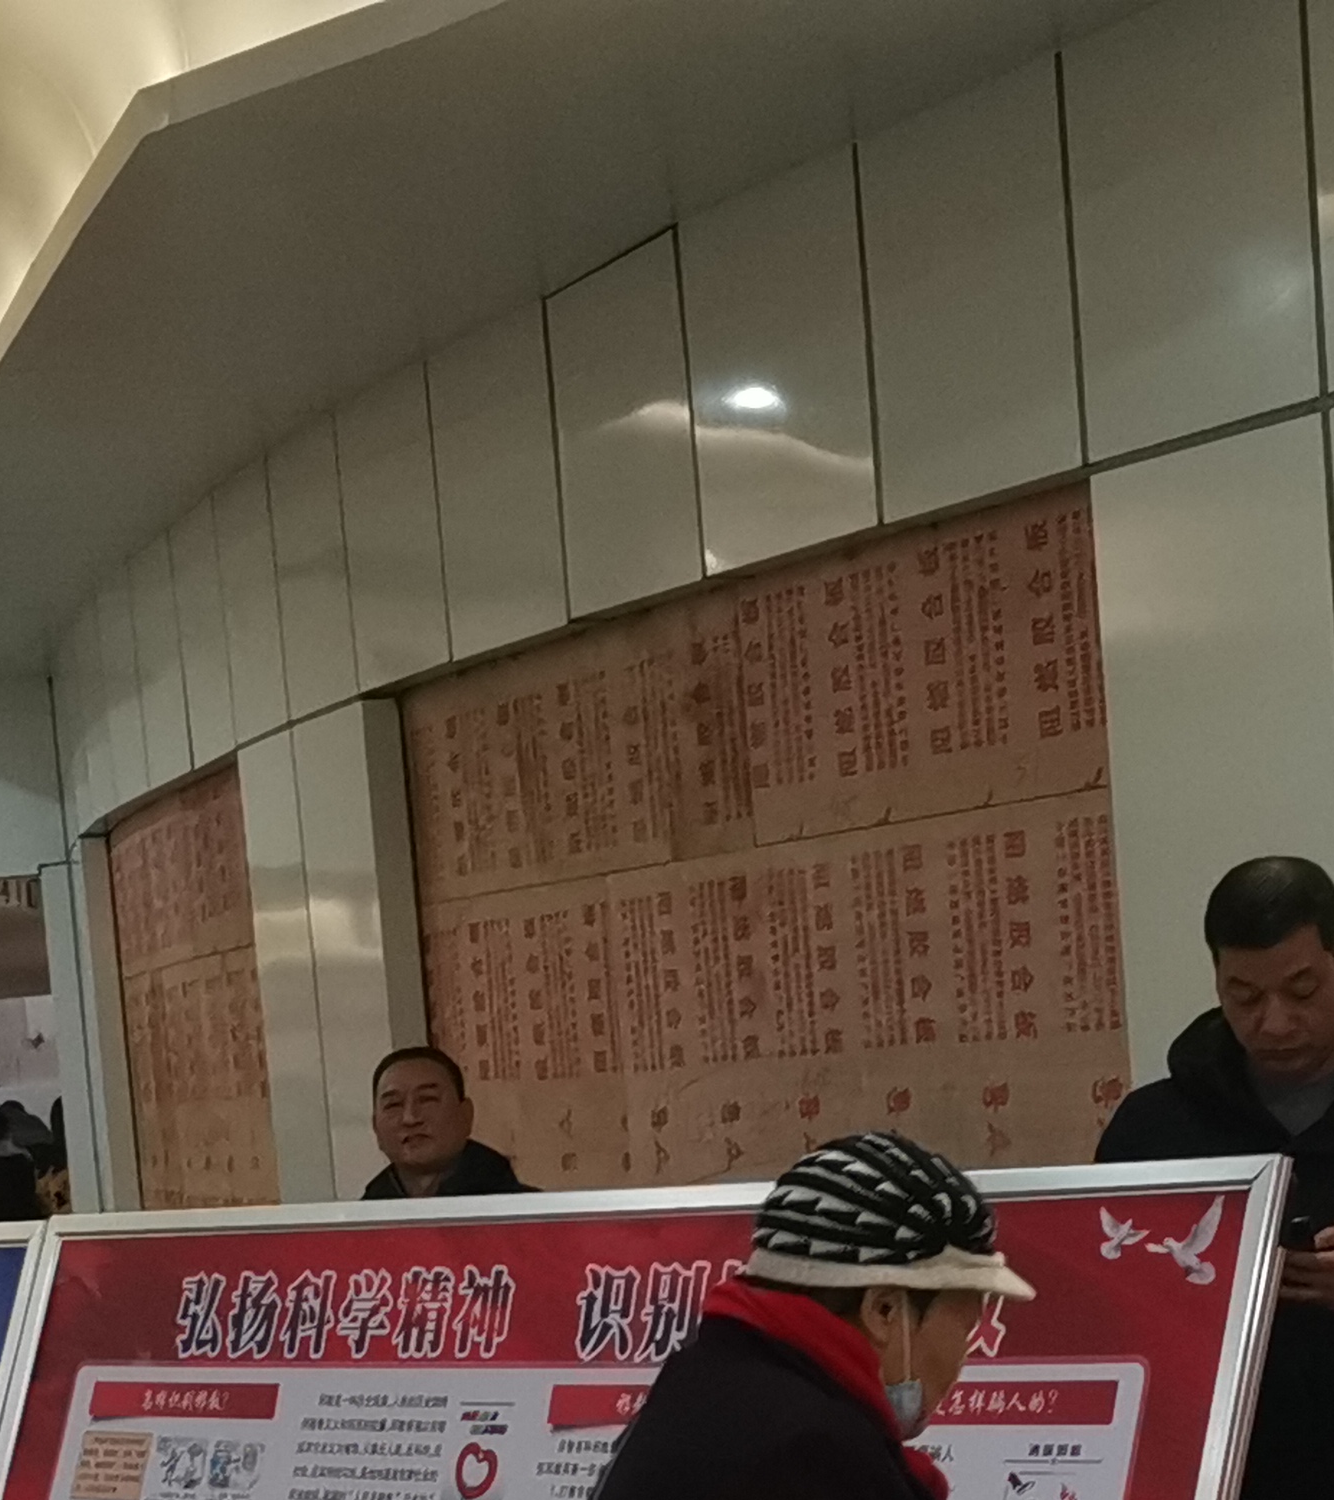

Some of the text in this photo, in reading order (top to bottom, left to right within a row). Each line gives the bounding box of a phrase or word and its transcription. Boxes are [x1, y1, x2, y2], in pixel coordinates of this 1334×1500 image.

[176, 1259, 747, 1363] 弘扬科学精神 识别
[934, 1388, 1059, 1416] 怎样骗人的?
